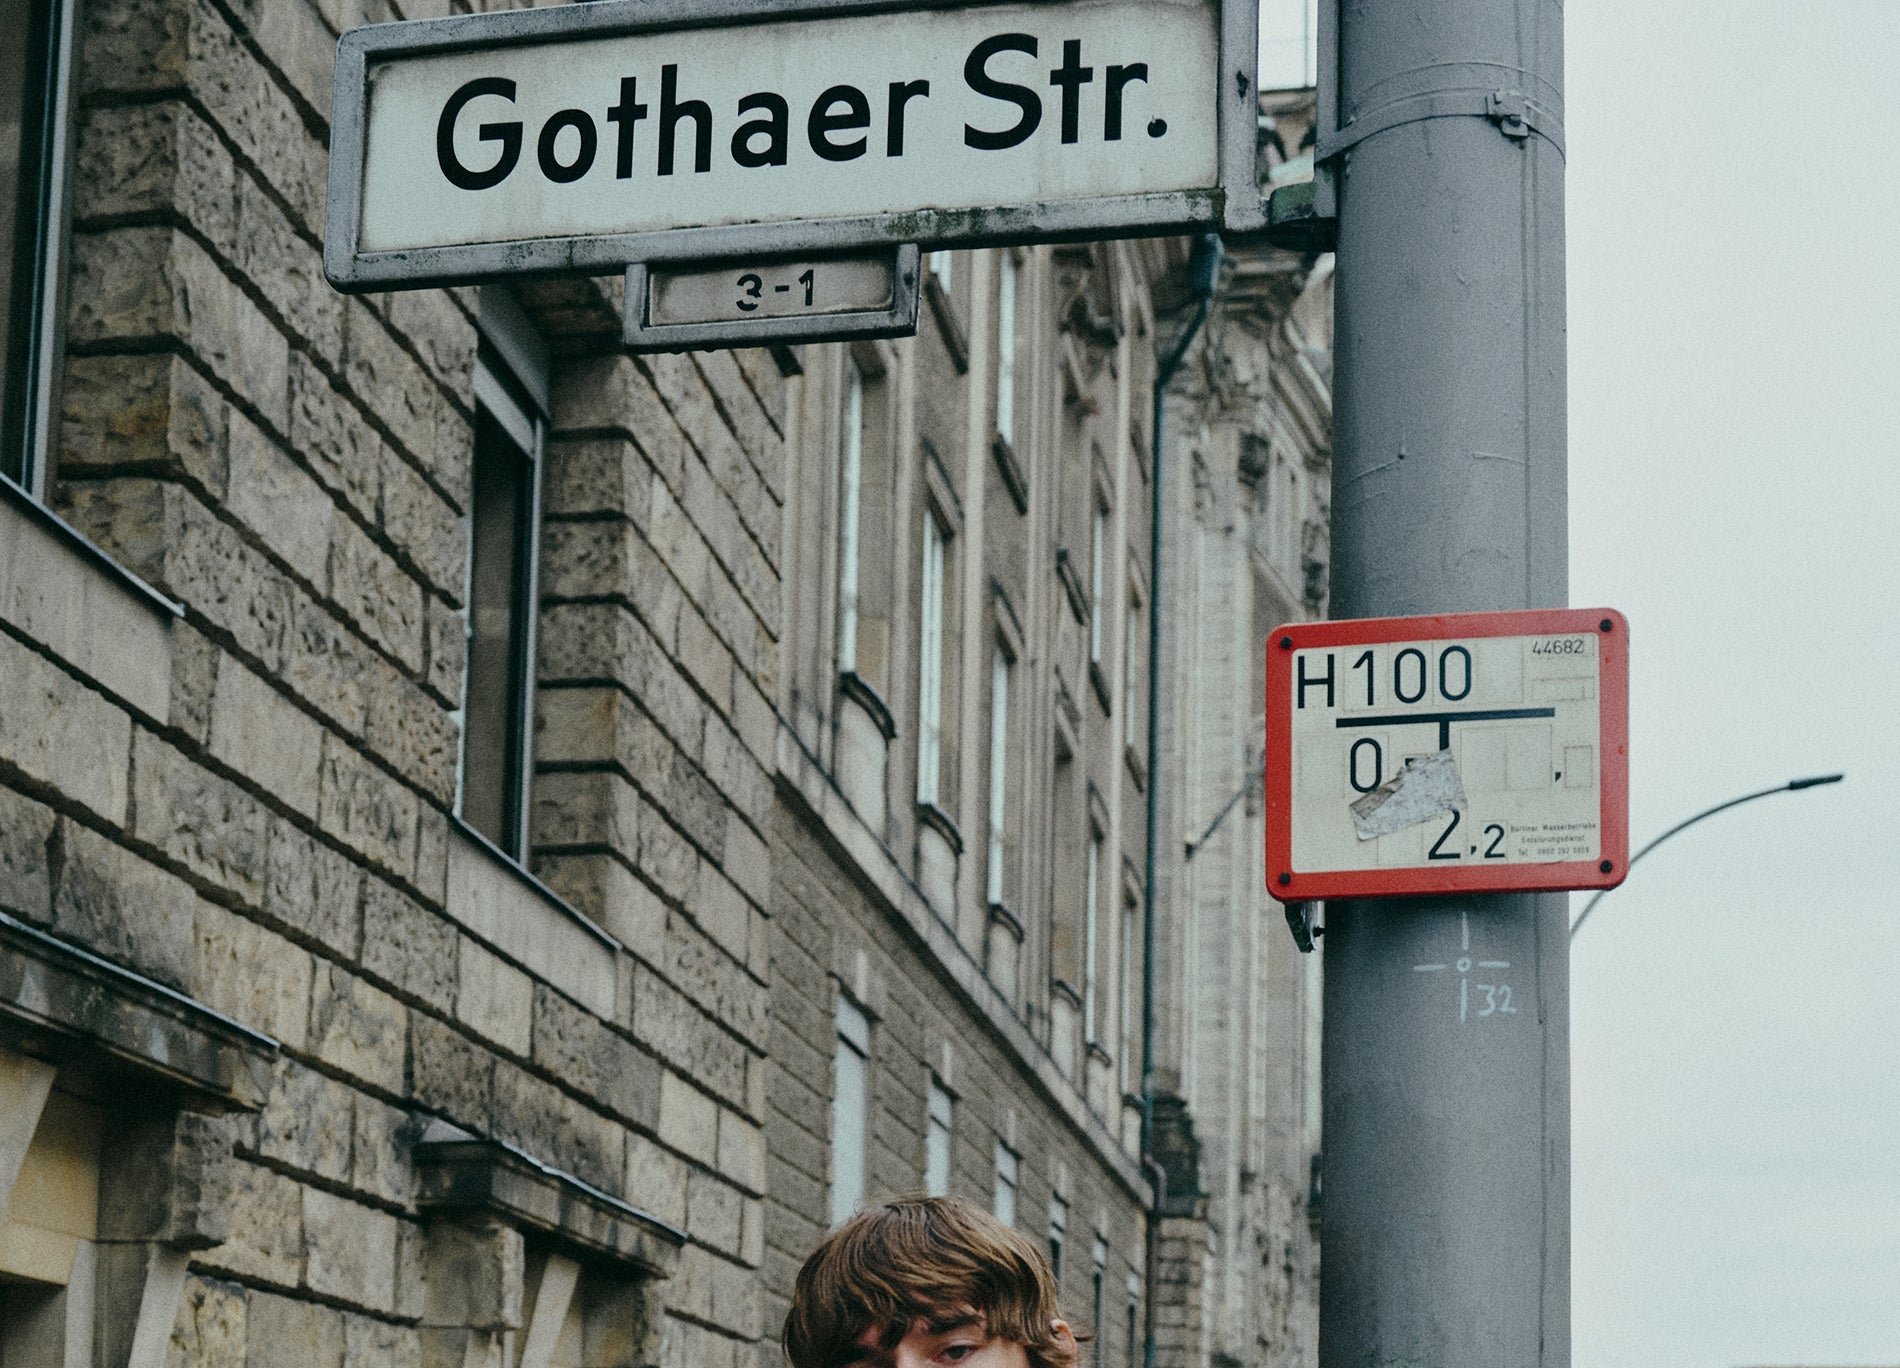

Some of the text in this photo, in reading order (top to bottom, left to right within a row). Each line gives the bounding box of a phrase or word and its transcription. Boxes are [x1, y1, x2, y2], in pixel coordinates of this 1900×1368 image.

[436, 33, 1169, 191] Gothaer Str.
[736, 269, 814, 312] 3-1
[1532, 639, 1584, 655] 44682
[1297, 645, 1472, 709] H100
[1477, 984, 1518, 1017] 32
